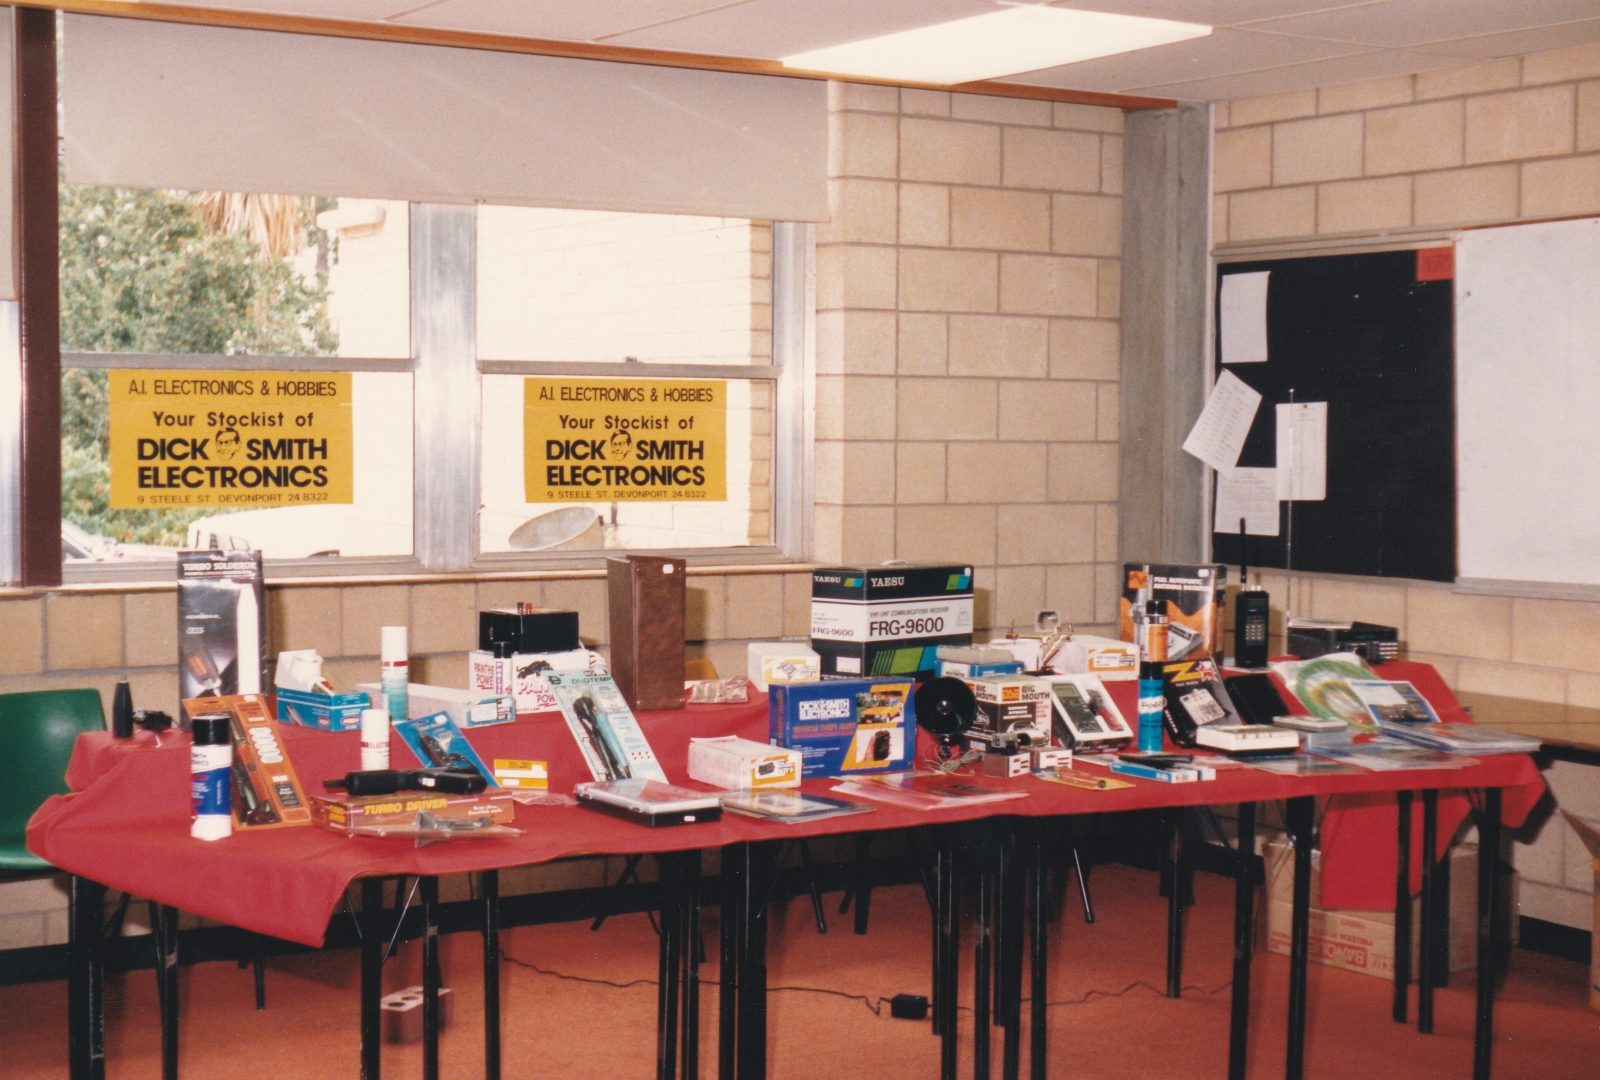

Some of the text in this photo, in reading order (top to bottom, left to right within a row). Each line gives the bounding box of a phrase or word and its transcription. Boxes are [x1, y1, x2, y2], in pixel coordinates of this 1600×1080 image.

[154, 379, 254, 396] ELECTRONICS
[260, 380, 270, 396] &
[276, 381, 337, 397] HOBBIES
[560, 386, 645, 402] ELECTRONICS
[650, 387, 658, 402] &
[663, 388, 714, 402] HOBBIES
[153, 411, 314, 428] Your Stockist of
[559, 414, 694, 430] Your Stockist of
[137, 437, 328, 461] DICK SMITH
[546, 439, 704, 461] DICK SMITH
[137, 465, 329, 489] ELECTRONICS
[546, 464, 706, 487] ELECTRONICS
[137, 495, 145, 504] 9
[150, 495, 191, 504] STEELE
[197, 494, 211, 504] ST
[218, 493, 282, 503] DEVONPORT
[547, 490, 554, 499] 9
[558, 490, 591, 499] STEELE
[596, 491, 607, 499] ST
[614, 490, 668, 499] DEVONPORT
[814, 575, 842, 584] YAESU
[870, 576, 905, 588] YAESU
[891, 608, 928, 616] COMMUNICATIONS
[812, 626, 854, 637] FRG-9600
[869, 616, 944, 638] FRG-9600
[474, 662, 494, 675] PANTHE
[477, 673, 494, 686] POWE
[1021, 685, 1035, 693] BIG
[975, 691, 997, 701] MOUTH
[1021, 691, 1051, 701] MOUTH
[363, 802, 402, 816] TURBO
[406, 799, 448, 812] DRIVER
